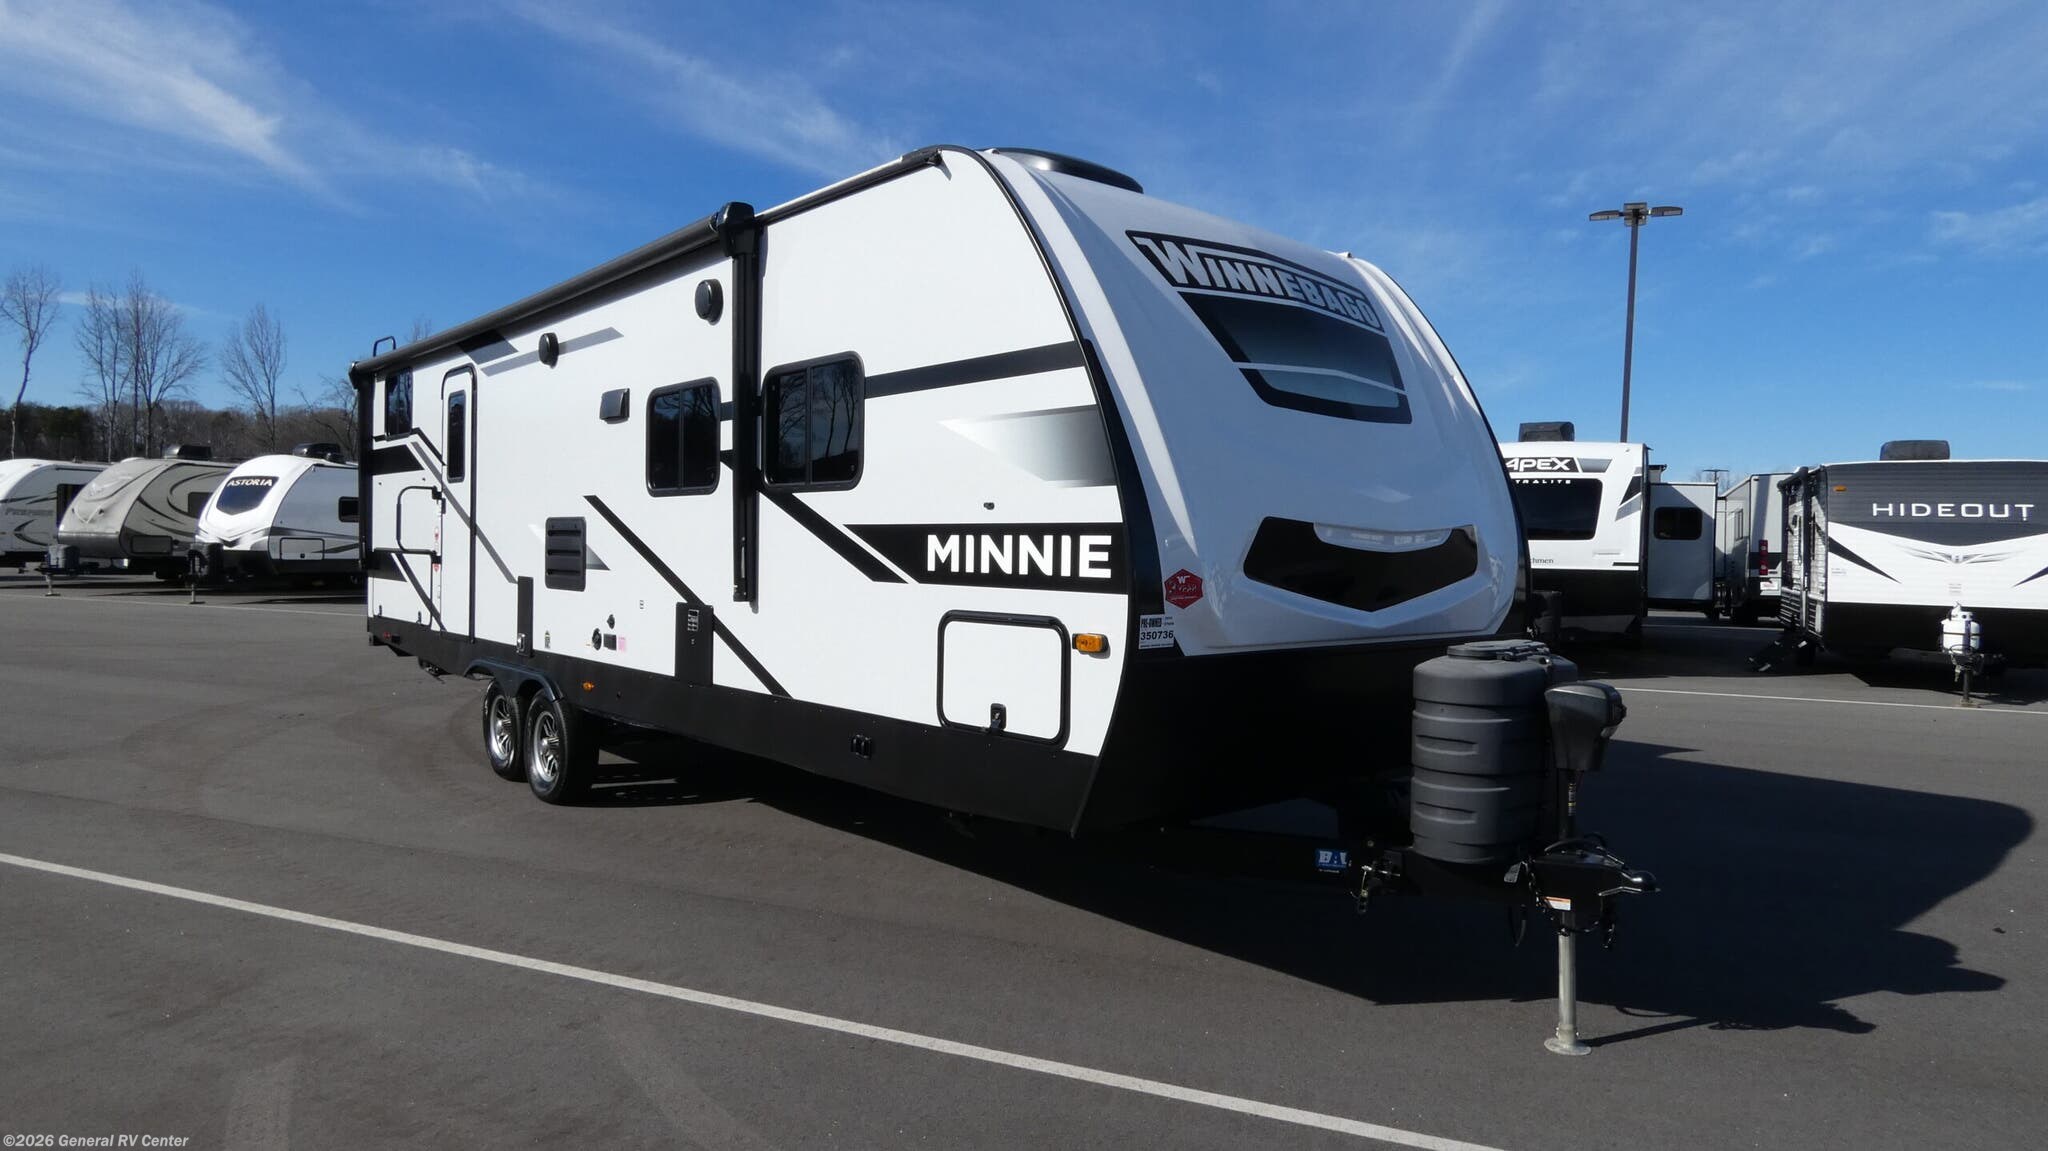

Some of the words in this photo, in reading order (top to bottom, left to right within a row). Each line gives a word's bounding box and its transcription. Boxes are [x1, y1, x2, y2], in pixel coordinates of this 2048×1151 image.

[1133, 236, 1379, 327] WINNEBAGO
[1505, 457, 1571, 472] APEX
[227, 478, 273, 488] ASTORIA
[1872, 503, 2035, 521] HIDEOUT
[926, 534, 1112, 579] MINNIE
[1140, 630, 1174, 641] 350736
